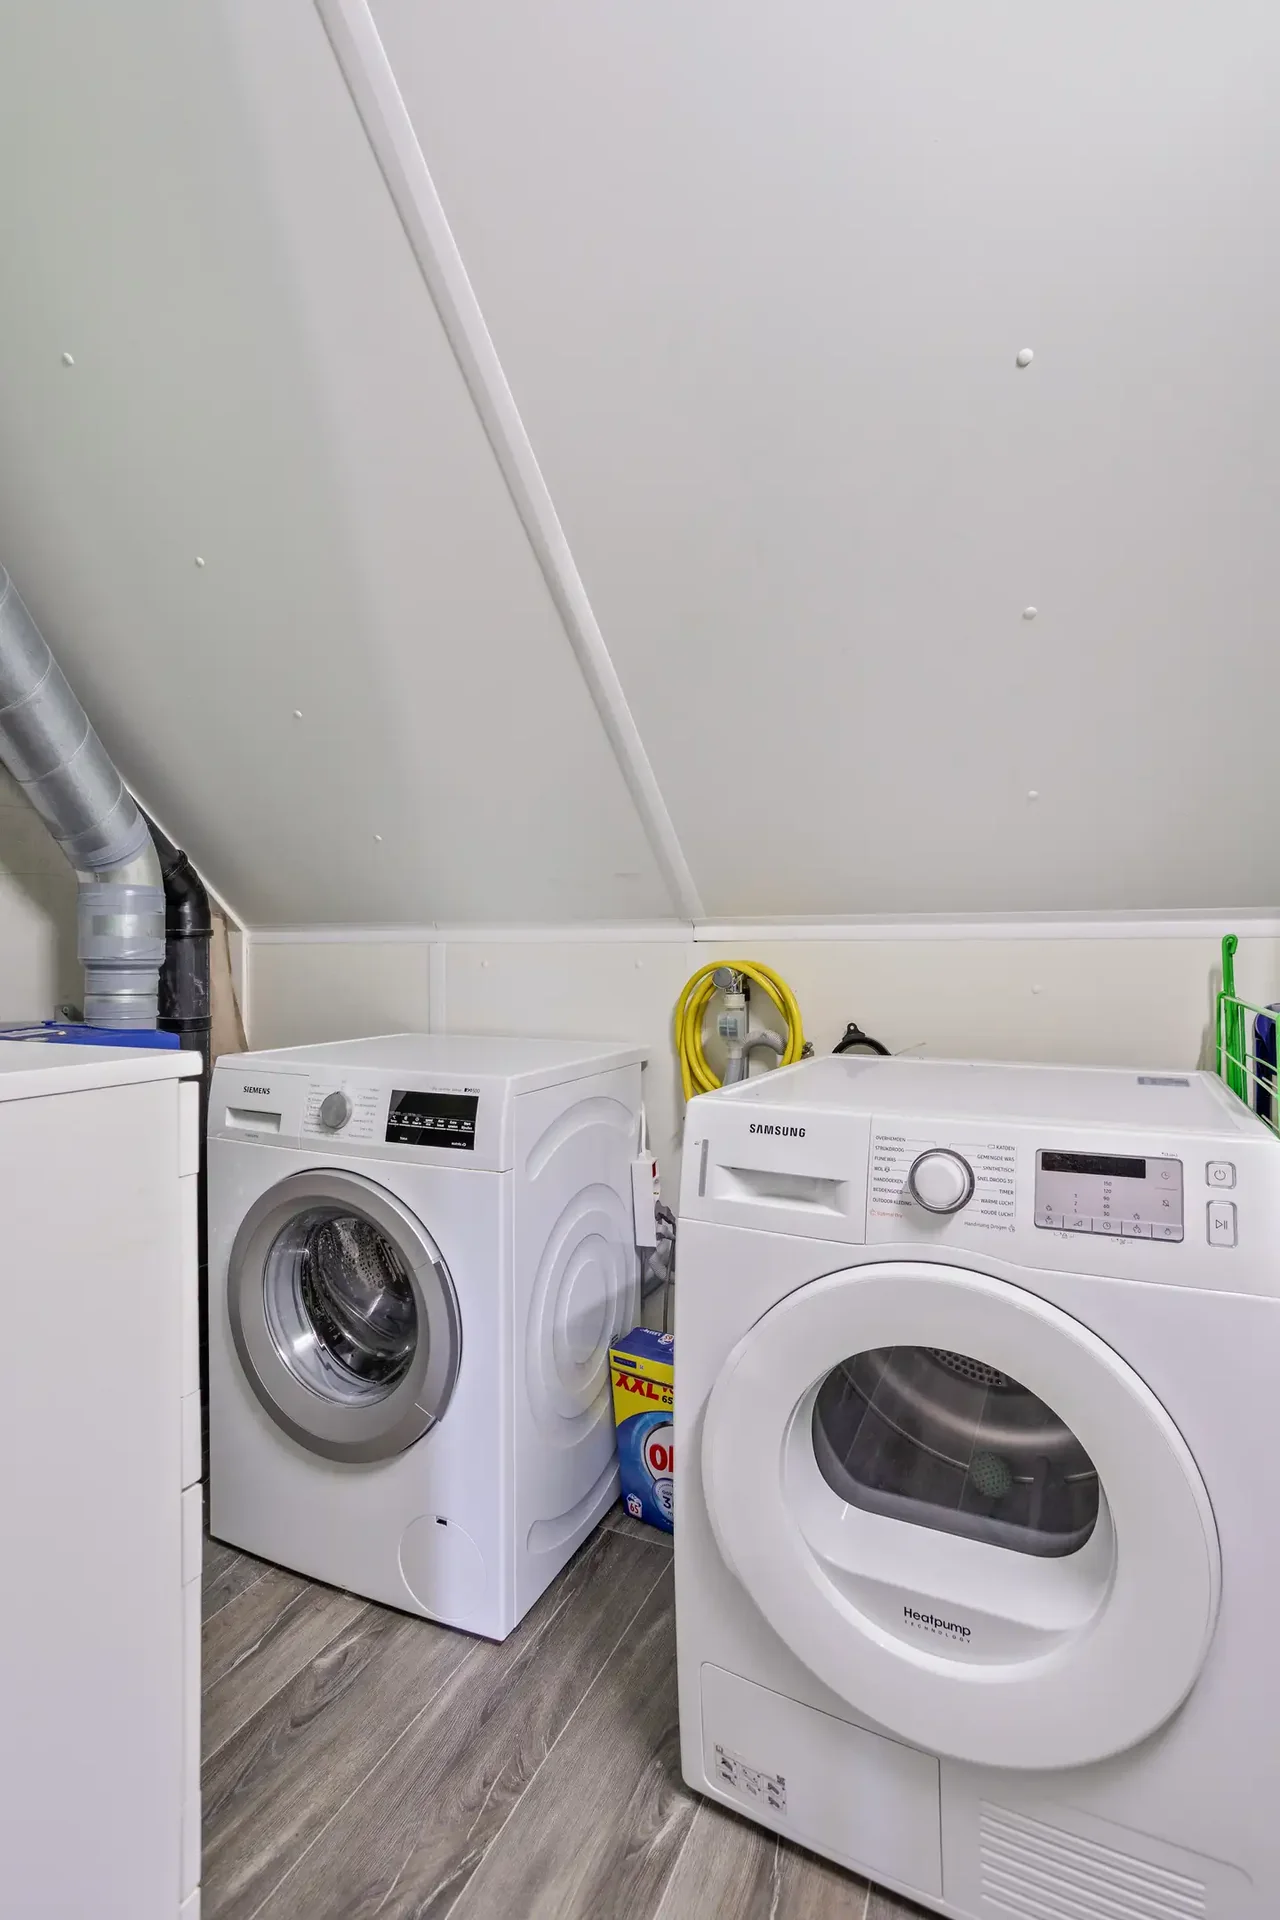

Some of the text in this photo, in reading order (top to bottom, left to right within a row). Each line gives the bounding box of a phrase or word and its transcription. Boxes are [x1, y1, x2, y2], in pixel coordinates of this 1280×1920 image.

[243, 1085, 270, 1095] SIEMENS
[749, 1123, 806, 1138] SAMSUNG
[615, 1373, 659, 1400] XXL
[661, 1395, 673, 1405] 65
[630, 1503, 639, 1513] 65
[903, 1606, 971, 1637] Heatpump
